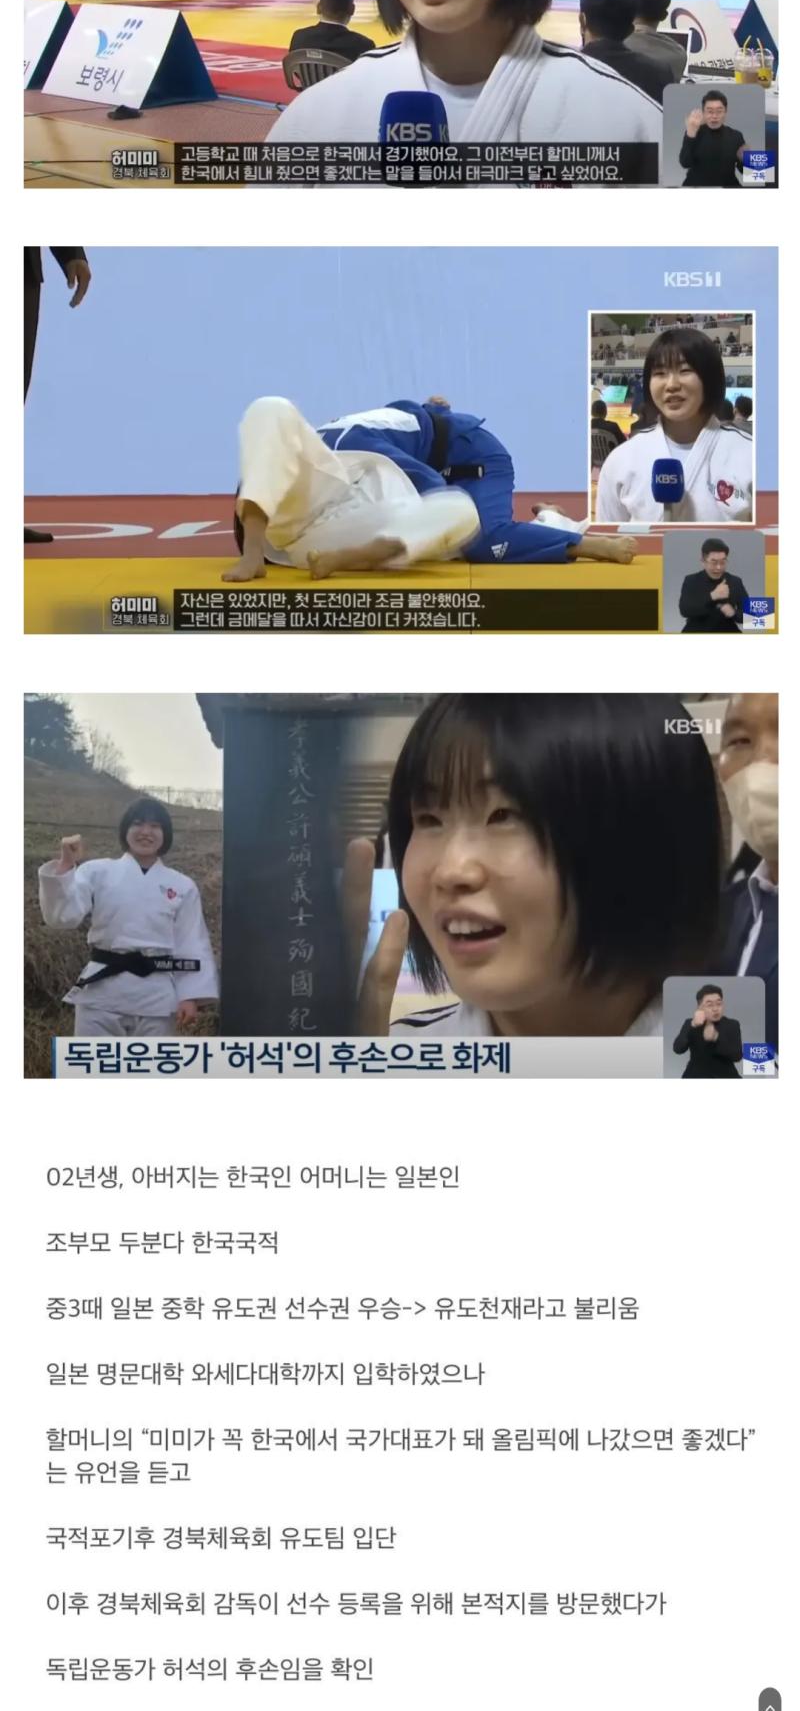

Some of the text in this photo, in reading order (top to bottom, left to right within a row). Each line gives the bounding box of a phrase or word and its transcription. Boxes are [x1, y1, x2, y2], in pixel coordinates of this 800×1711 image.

[76, 65, 124, 93] 보령시
[387, 122, 432, 142] KBS
[656, 474, 678, 484] KBS
[47, 1166, 458, 1189] 02년생, 아버지는 한국인 어머니는 일본인
[46, 1231, 277, 1254] 조부모 두분다 한국국적
[46, 1297, 639, 1320] 중3때 일본 중학 유도권 선수권 우승-> 유도천재라고 불리움
[46, 1461, 190, 1484] 는 유언을 듣고
[46, 1526, 396, 1550] 국적포기후 경북체육회 유도팀 입단
[47, 1658, 372, 1681] 독립운동가 허석의 후손임을 확인
